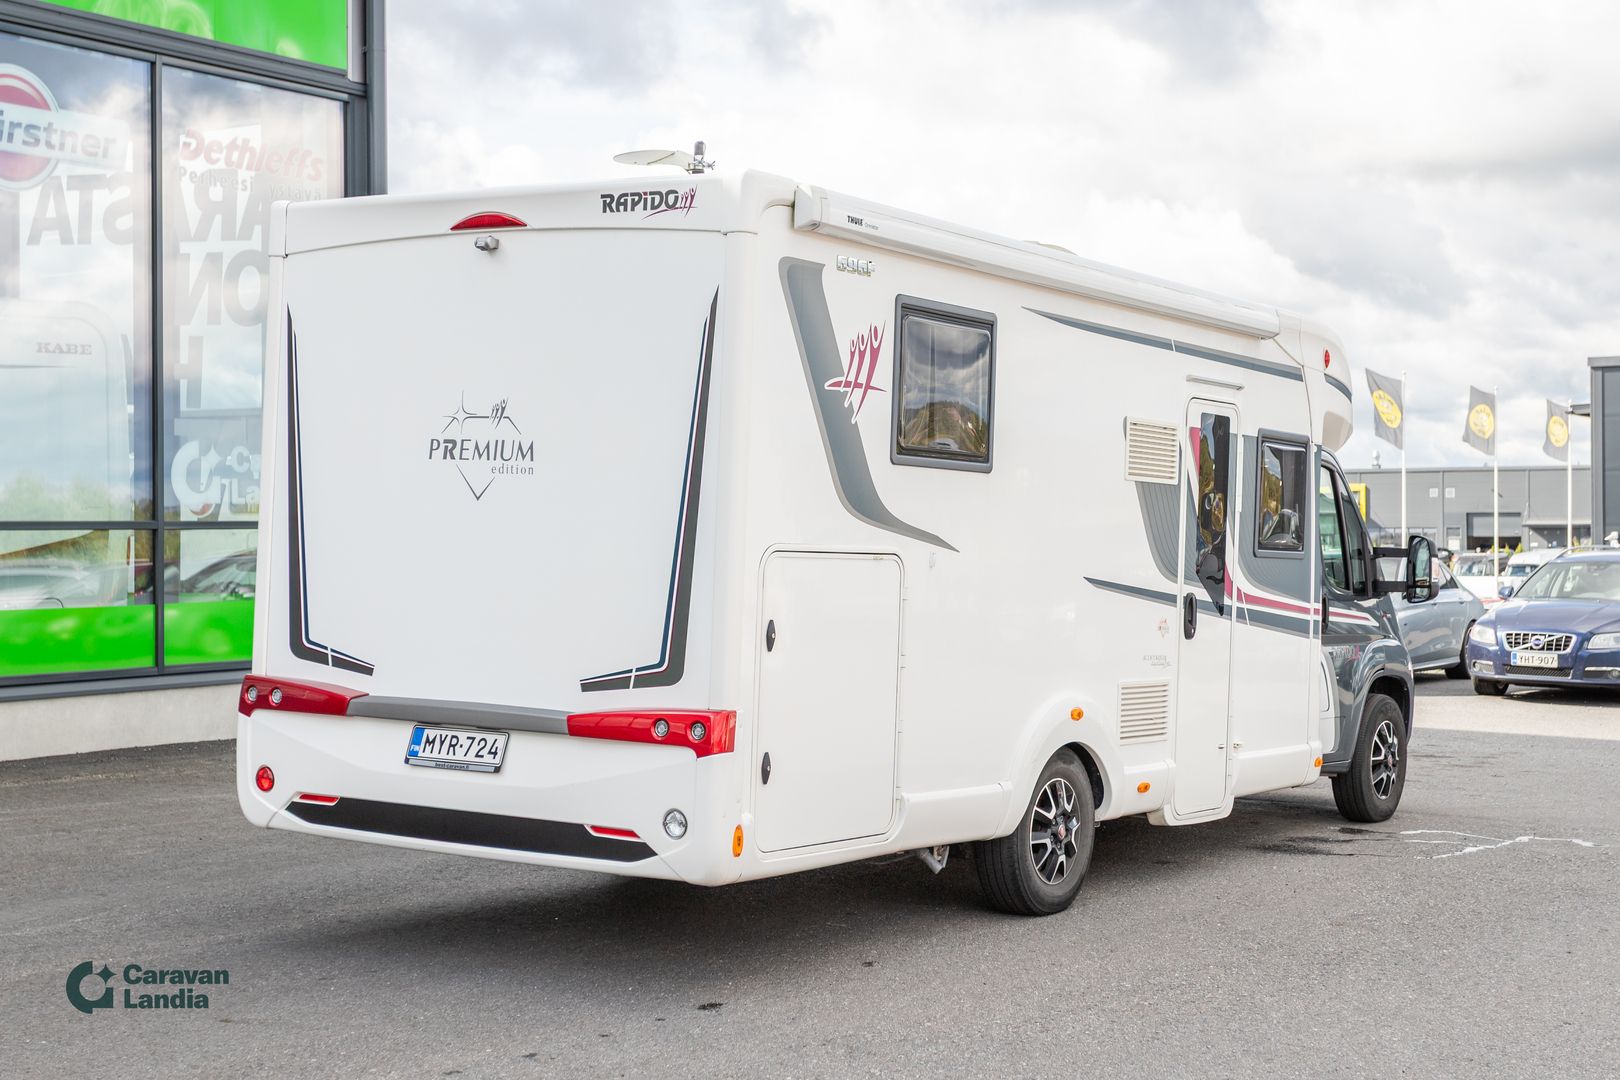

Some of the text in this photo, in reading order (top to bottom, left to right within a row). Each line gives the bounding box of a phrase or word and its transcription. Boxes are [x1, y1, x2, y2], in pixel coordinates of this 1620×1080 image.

[0, 109, 118, 160] rstner
[179, 127, 325, 182] Dethleffs
[847, 215, 864, 227] THULE
[35, 341, 93, 356] KABE
[428, 438, 535, 462] PREMIUM
[491, 463, 534, 475] edition
[422, 733, 499, 760] MYR-724
